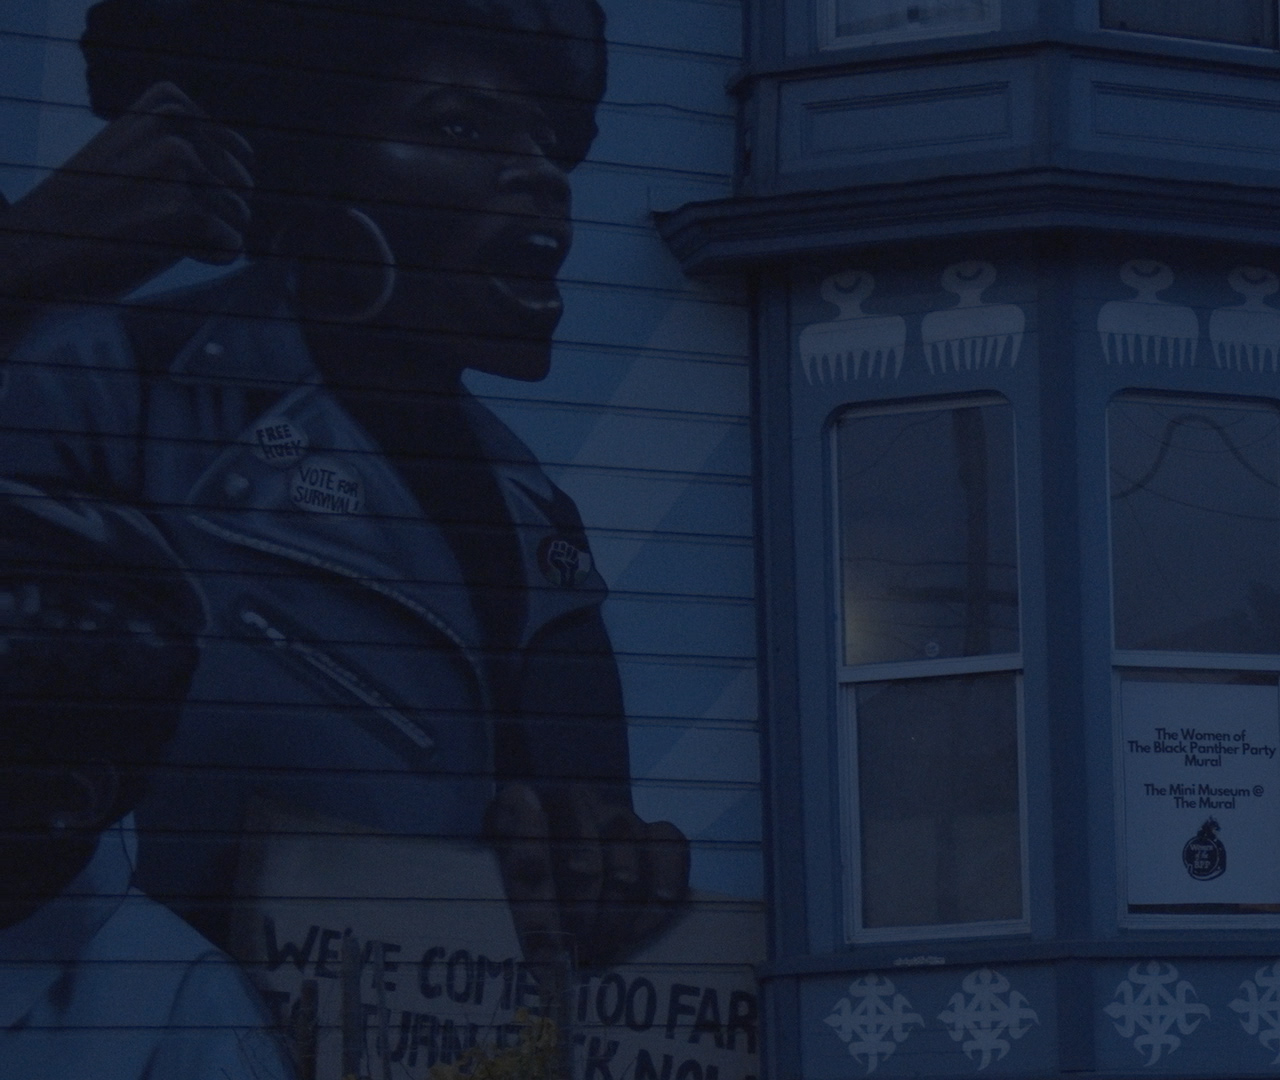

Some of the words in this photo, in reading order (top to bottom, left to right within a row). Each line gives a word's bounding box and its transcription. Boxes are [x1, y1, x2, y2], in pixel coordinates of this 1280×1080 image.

[255, 423, 292, 443] FREE
[298, 465, 337, 490] VOTE
[337, 479, 359, 498] FOR
[1155, 727, 1179, 741] The
[1180, 728, 1231, 742] Women
[1233, 729, 1247, 742] of
[1127, 740, 1151, 755] The
[1153, 741, 1187, 754] Black
[1190, 741, 1240, 755] Panther
[1242, 743, 1277, 759] Party
[1184, 754, 1223, 767] Mural
[1143, 783, 1167, 797] The
[1169, 783, 1197, 797] Mini
[1198, 784, 1251, 797] Museum
[1252, 784, 1265, 798] @
[1173, 796, 1197, 809] The
[1199, 796, 1236, 810] Mural
[418, 945, 543, 1014] COME
[575, 970, 657, 1032] TOO
[666, 983, 759, 1054] FAR
